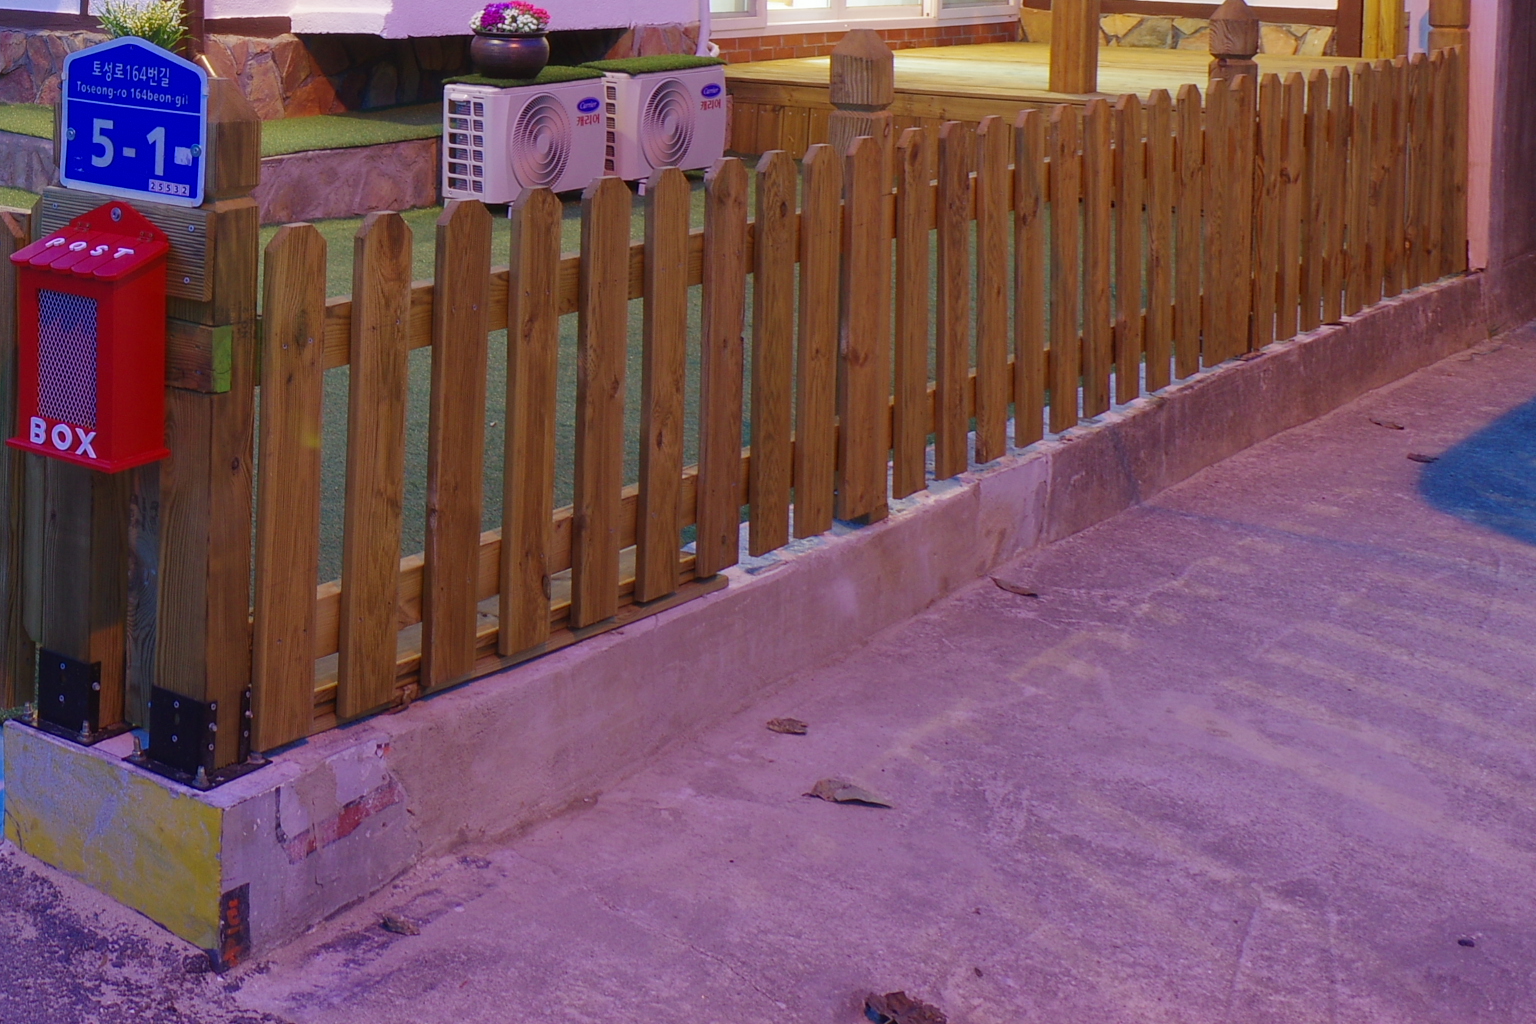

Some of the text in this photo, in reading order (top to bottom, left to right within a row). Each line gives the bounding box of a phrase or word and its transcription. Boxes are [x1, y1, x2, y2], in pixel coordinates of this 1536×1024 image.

[92, 60, 170, 87] 토성로164번길
[76, 81, 189, 107] Toseong-ro 164beon-gil
[700, 99, 722, 111] 캐리어
[576, 113, 600, 126] 캐리어
[150, 181, 188, 195] 25532
[45, 237, 135, 259] POST
[30, 416, 97, 459] BOX
